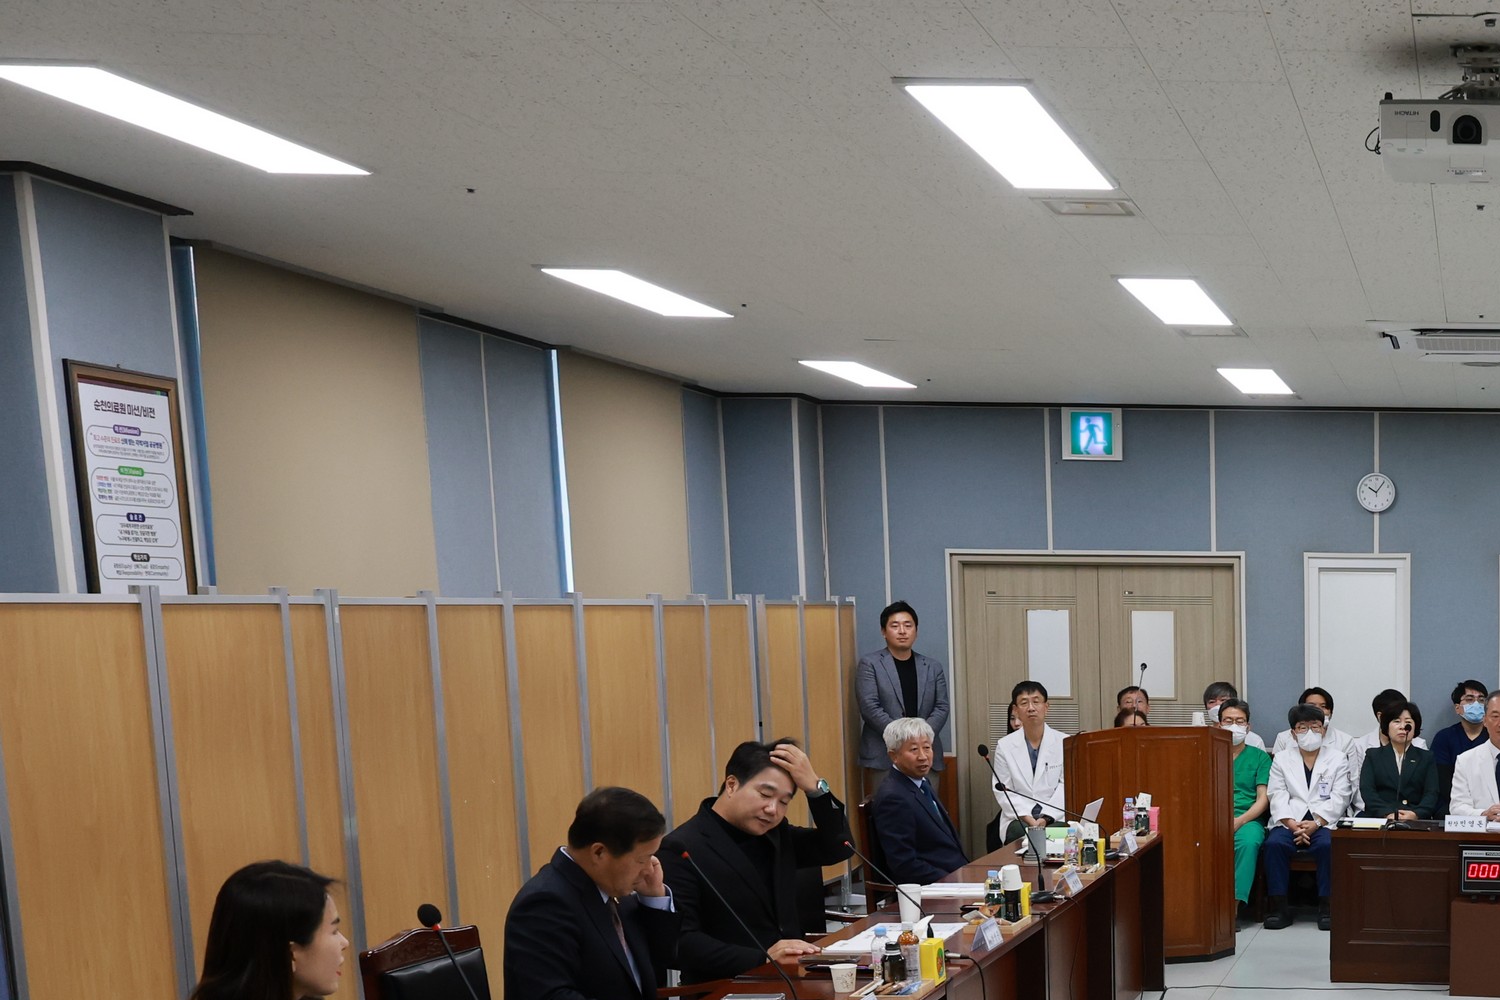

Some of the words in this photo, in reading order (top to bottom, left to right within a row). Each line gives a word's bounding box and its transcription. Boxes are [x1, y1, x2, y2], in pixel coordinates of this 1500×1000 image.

[94, 399, 126, 414] 순천의료원
[127, 404, 156, 418] 미션/비전
[1468, 864, 1499, 878] 000
